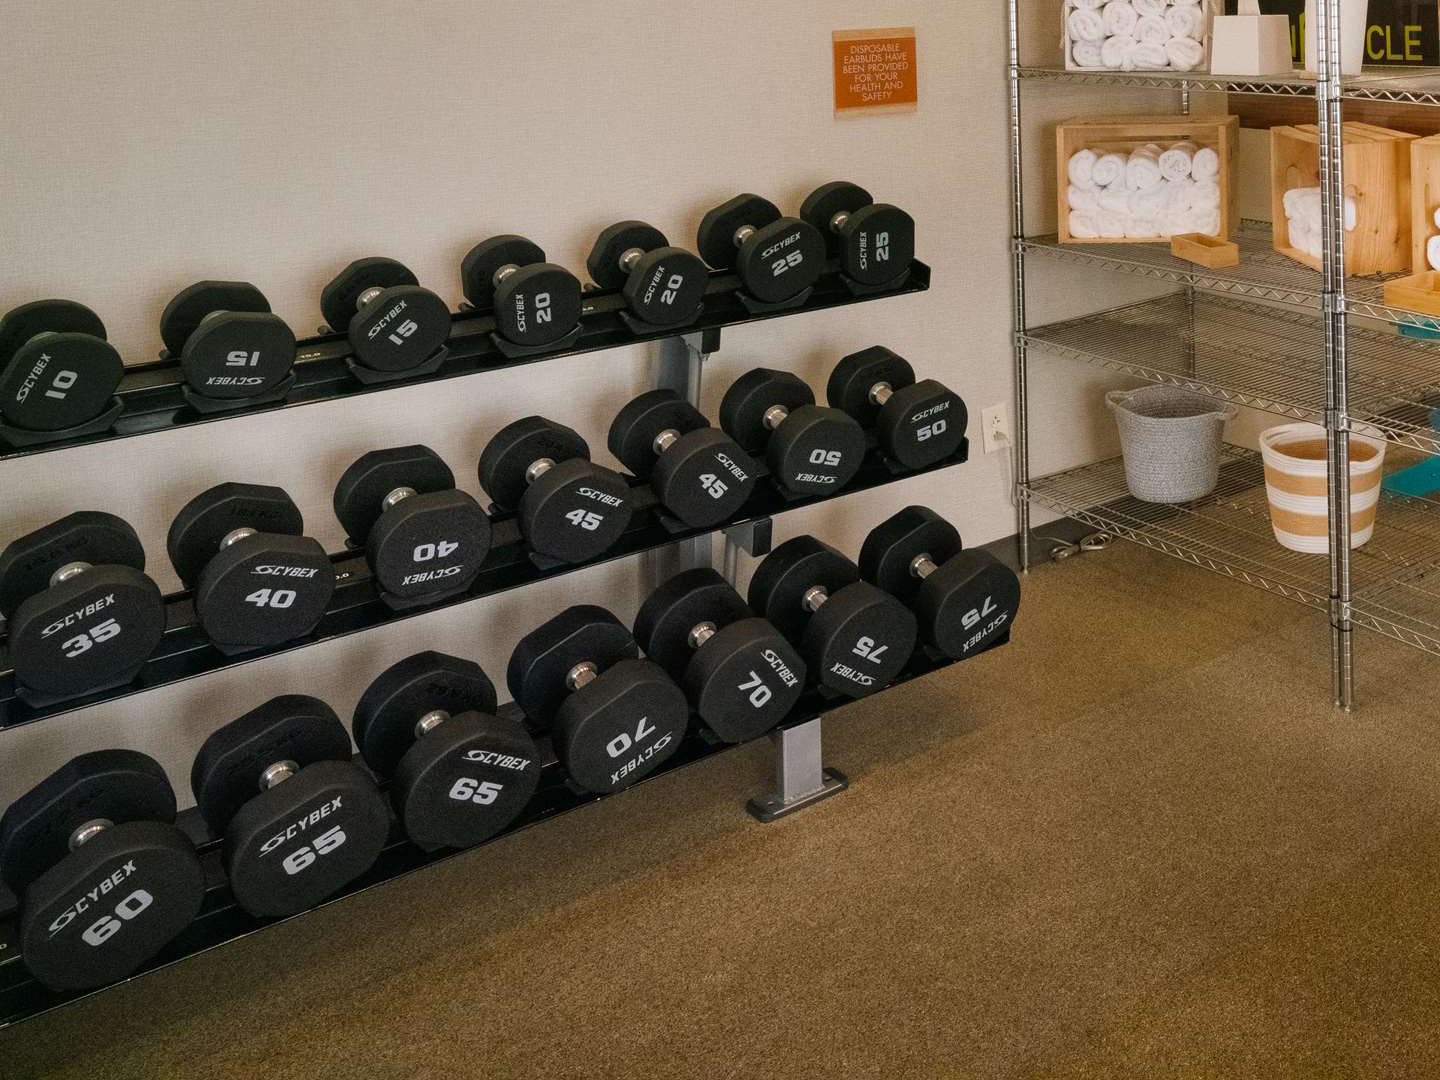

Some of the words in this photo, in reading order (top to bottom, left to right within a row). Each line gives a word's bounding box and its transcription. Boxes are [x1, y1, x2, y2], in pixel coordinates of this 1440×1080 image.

[850, 43, 900, 54] DISPOSABLE
[1366, 24, 1424, 61] CLE
[842, 64, 865, 74] BEEN
[867, 61, 909, 73] PROVIDED
[844, 54, 882, 64] EARBUDS
[885, 52, 908, 61] HAVE
[849, 83, 880, 93] HEALTH
[884, 81, 904, 89] AND
[855, 74, 872, 83] FOR
[875, 72, 898, 81] YOUR
[862, 91, 893, 101] SAFETY
[876, 231, 889, 262] 25
[771, 250, 803, 277] 25
[660, 274, 683, 305] 20
[535, 292, 552, 324] 20
[388, 319, 418, 345] 15
[225, 351, 260, 366] 15
[45, 370, 78, 399] 10
[916, 419, 946, 442] 50
[809, 449, 842, 466] 50
[699, 474, 729, 499] 45
[565, 509, 604, 531] 45
[413, 540, 459, 562] 40
[245, 588, 296, 608] 40
[961, 596, 997, 630] 75
[62, 618, 121, 658] 35
[852, 636, 889, 664] 75
[738, 670, 772, 708] 70
[606, 716, 656, 758] 70
[449, 777, 503, 805] 65
[282, 825, 346, 875] 65
[82, 889, 154, 946] 60
